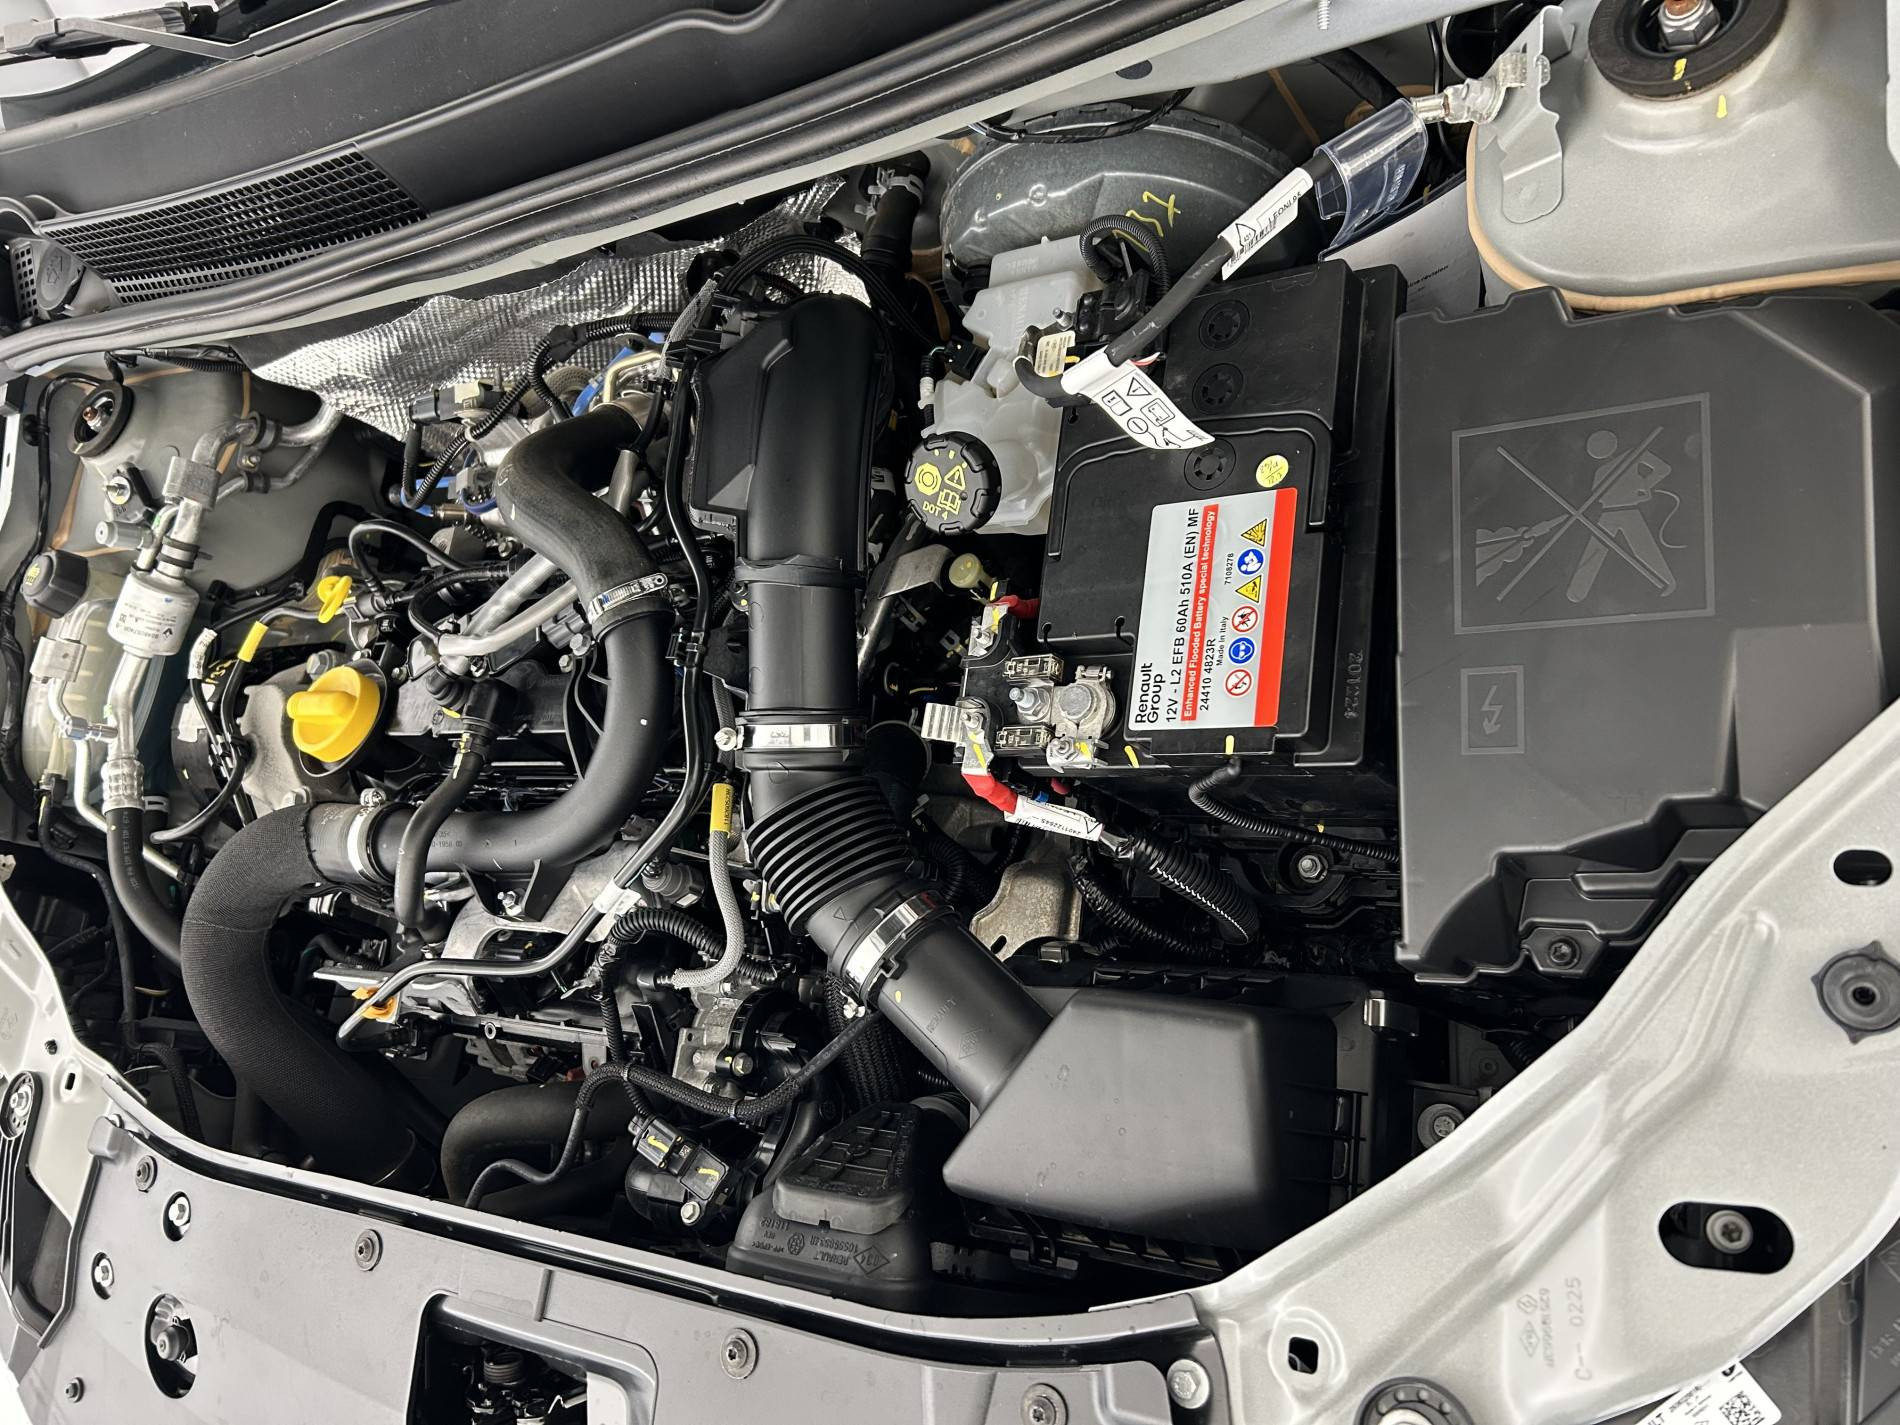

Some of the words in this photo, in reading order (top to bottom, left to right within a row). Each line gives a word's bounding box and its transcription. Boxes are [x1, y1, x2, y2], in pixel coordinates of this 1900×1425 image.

[922, 500, 942, 517] DOT
[941, 510, 949, 521] 4
[1188, 508, 1199, 527] MF
[1184, 531, 1199, 560] (EN)
[1202, 510, 1216, 562] technology
[1180, 562, 1194, 595] 510A
[1198, 562, 1210, 594] special
[1224, 552, 1234, 586] 7108278
[1175, 599, 1189, 632] 60Ah
[1193, 596, 1206, 630] Battery
[1219, 616, 1230, 639] Italy
[1172, 636, 1185, 664] EFB
[1188, 631, 1200, 668] Flooded
[1204, 638, 1216, 674] 4823R
[1215, 647, 1224, 666] Made
[1135, 662, 1153, 724] Renault
[1171, 668, 1182, 685] L2
[1147, 673, 1166, 724] Group
[1166, 698, 1178, 723] 12V
[1184, 670, 1196, 718] Enhanced
[1200, 677, 1211, 712] 24410
[813, 1250, 851, 1266] RENAULT
[1564, 1277, 1585, 1327] 0225
